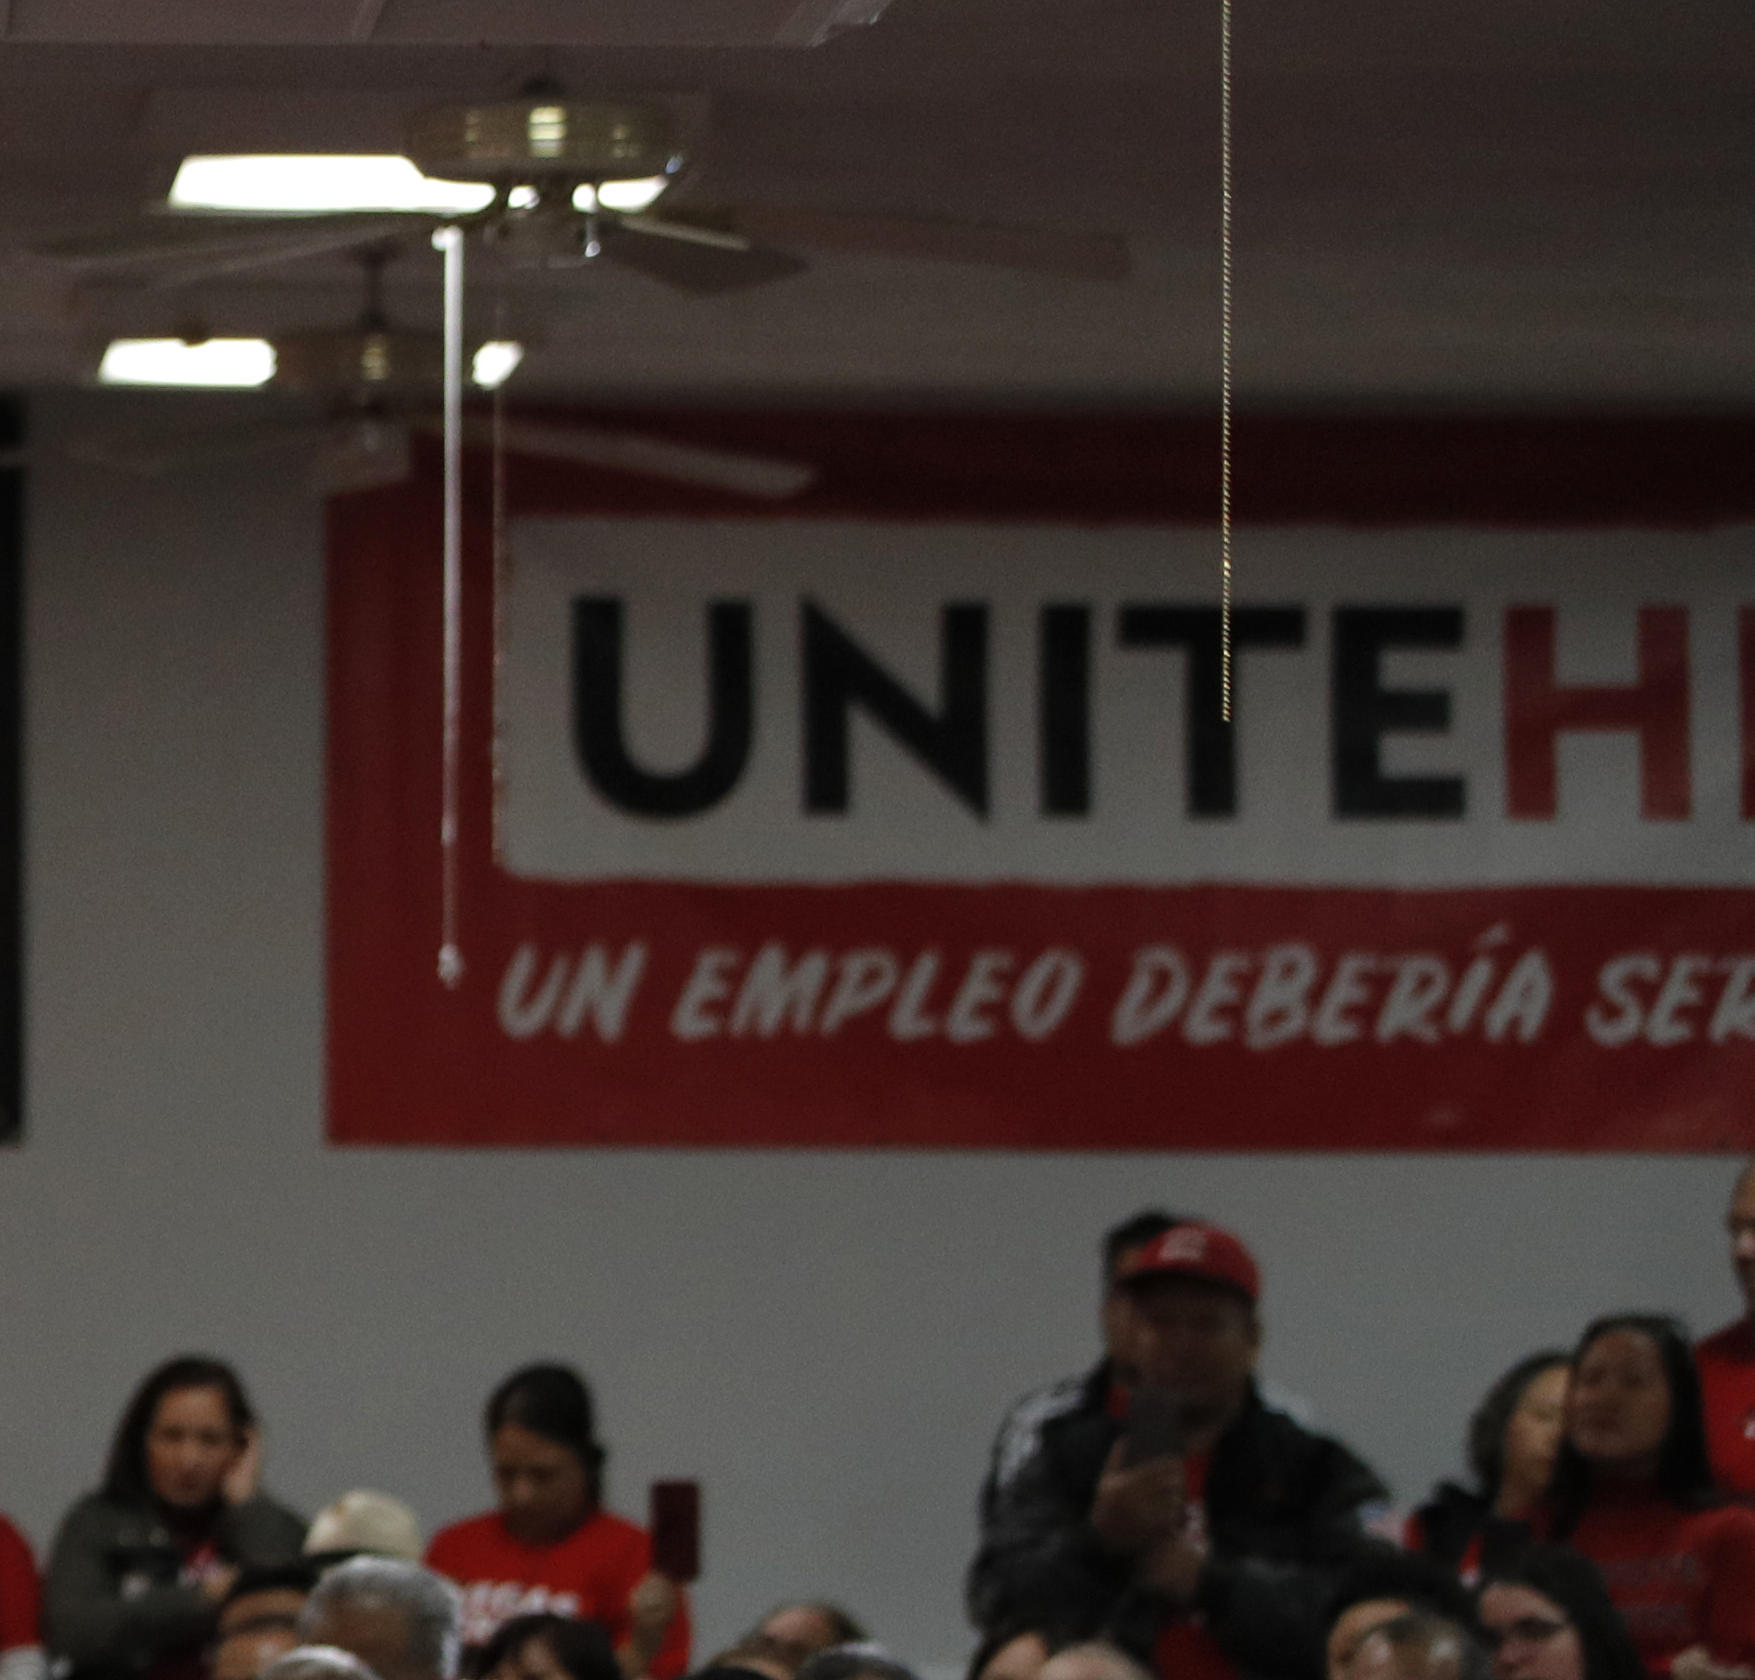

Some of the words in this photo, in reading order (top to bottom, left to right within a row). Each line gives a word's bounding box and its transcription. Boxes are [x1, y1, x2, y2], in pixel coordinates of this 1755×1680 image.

[571, 596, 1755, 824] UNITEH
[497, 938, 648, 1046] UN
[668, 936, 1087, 1046] EMPLEO
[1108, 920, 1557, 1052] DEBERÍA
